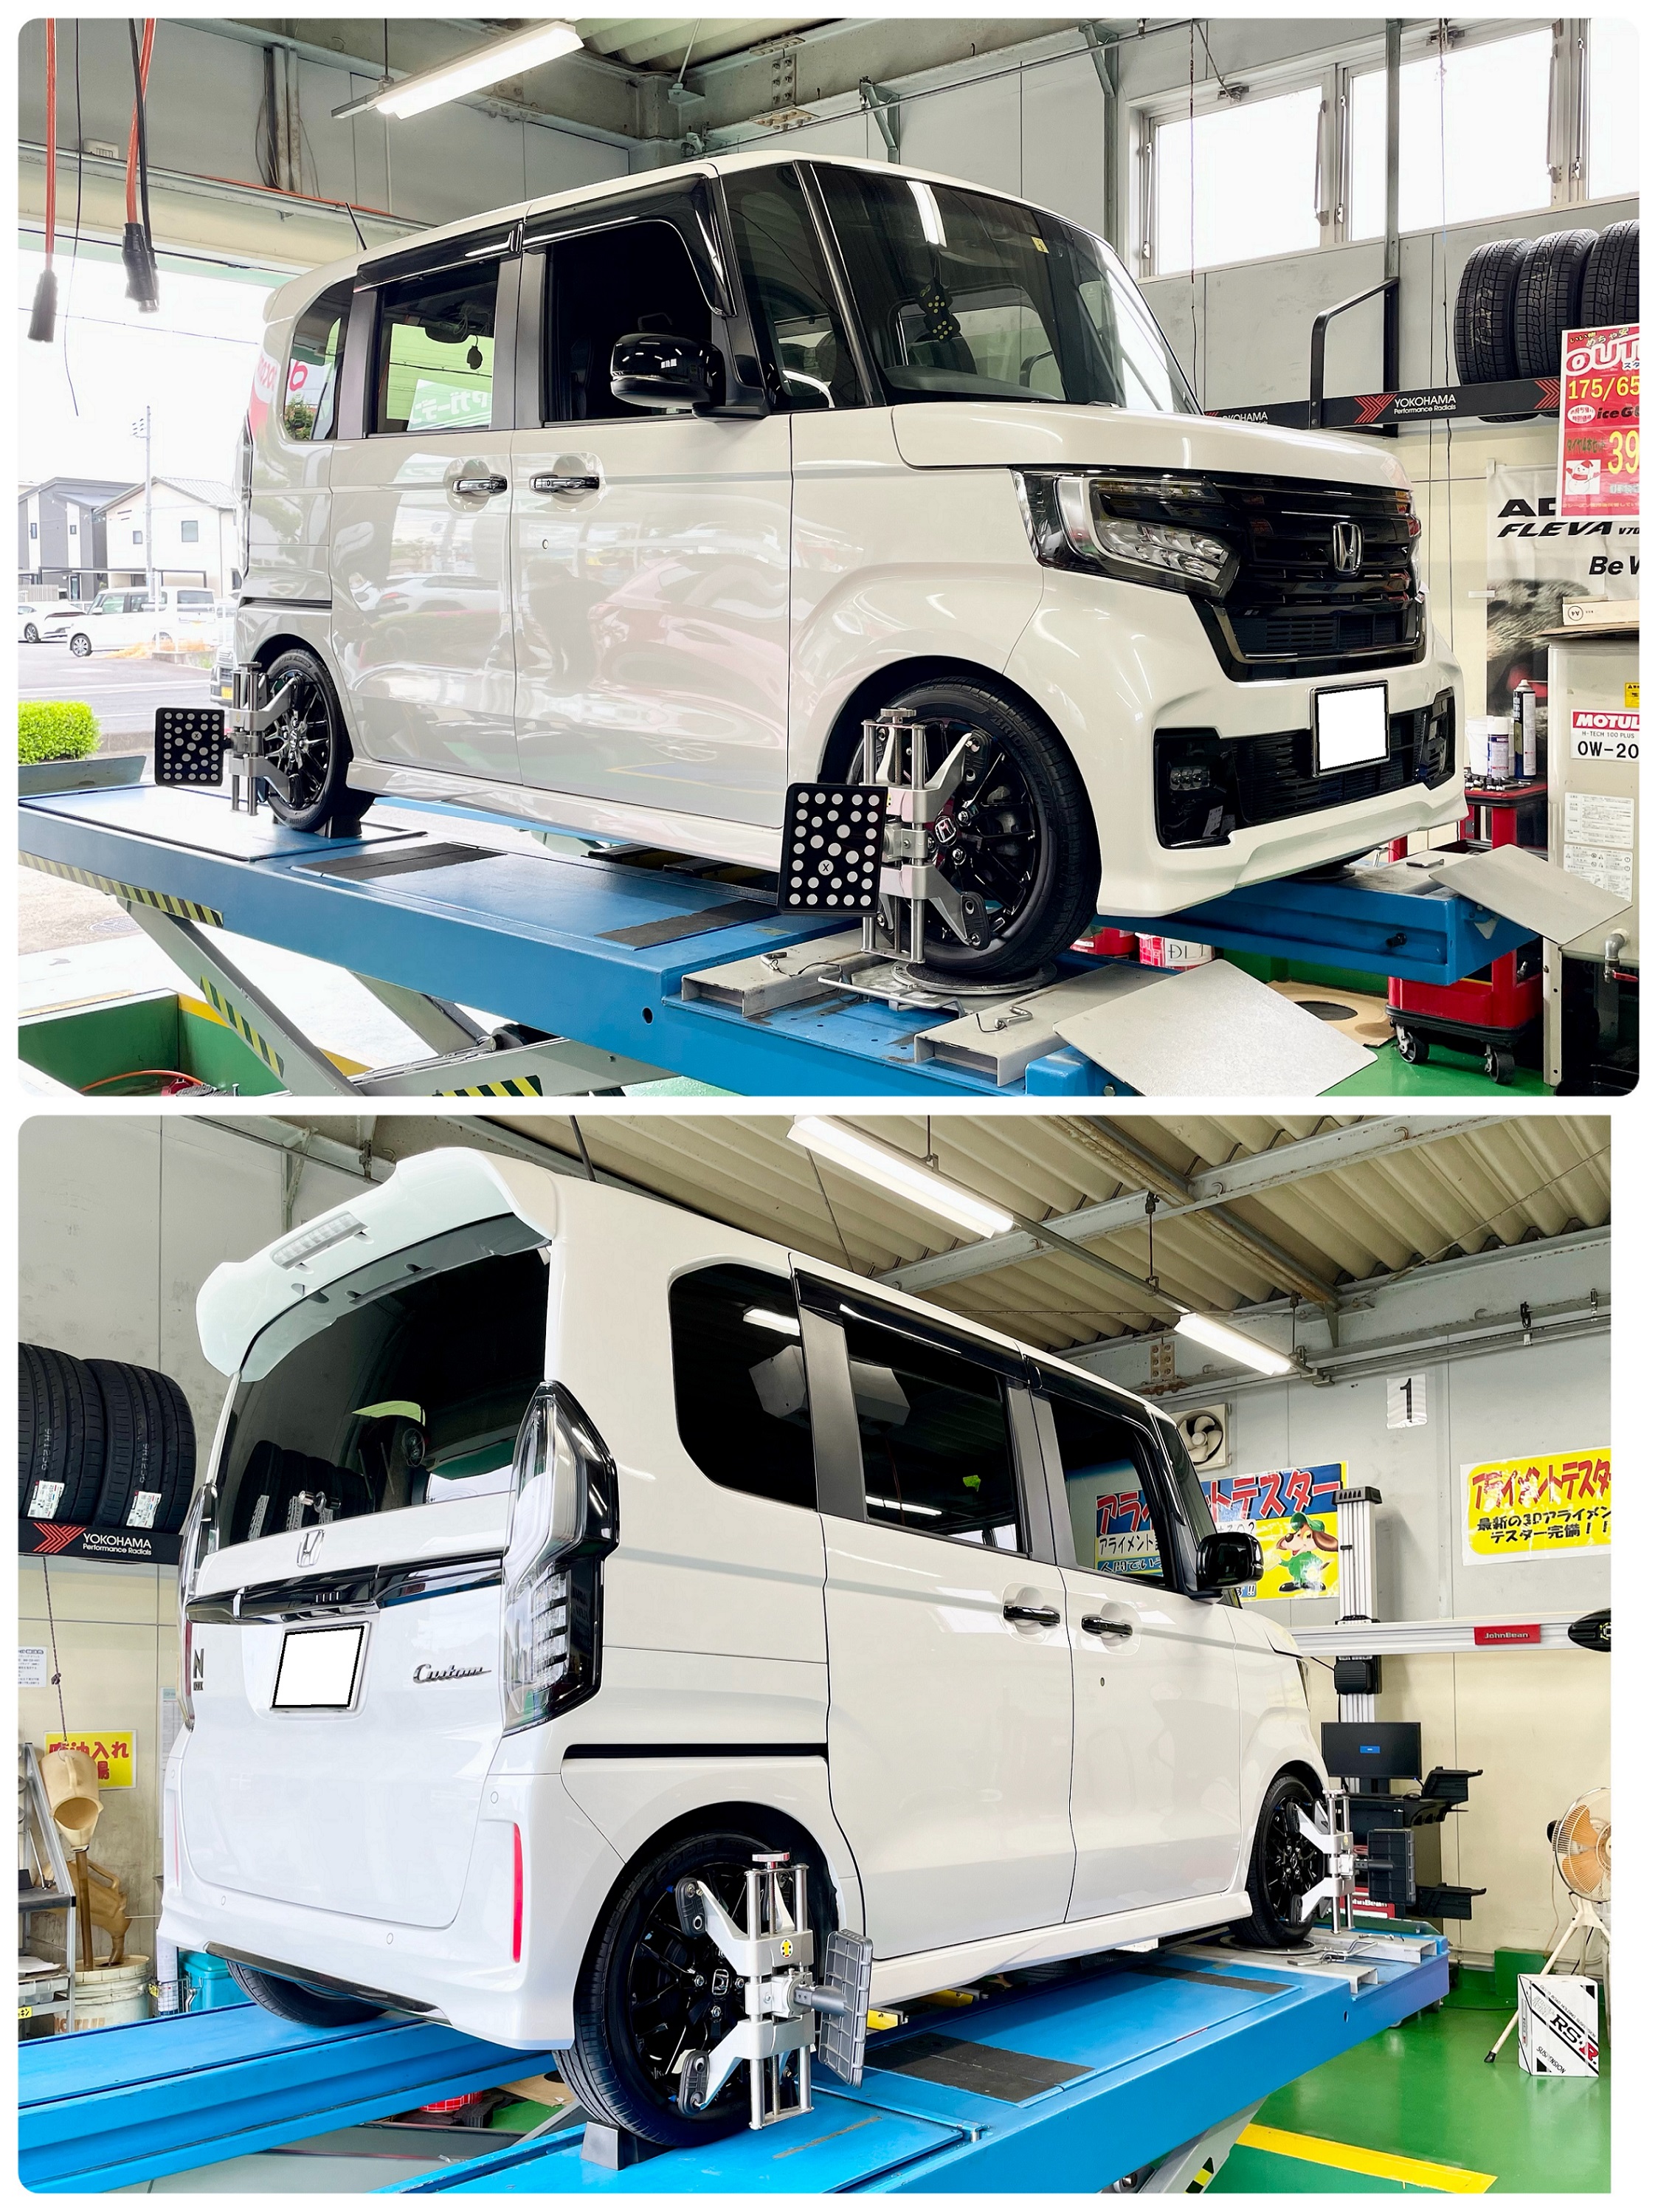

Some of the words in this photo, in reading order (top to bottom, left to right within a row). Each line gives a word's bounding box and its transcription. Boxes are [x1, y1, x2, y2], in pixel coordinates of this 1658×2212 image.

[1394, 393, 1457, 407] YOKOHAMA
[1394, 405, 1433, 415] Performance
[1434, 403, 1457, 413] Radials
[1497, 521, 1613, 538] FLEVA
[1589, 556, 1623, 575] Be
[1576, 714, 1640, 729] MOTUL
[1399, 1377, 1413, 1422] 1
[1472, 1458, 1612, 1509] アライメントテスタ
[83, 1532, 152, 1549] YOKOHAMA
[83, 1543, 127, 1554] Performance
[128, 1546, 152, 1556] Radials
[413, 1664, 492, 1684] Custom
